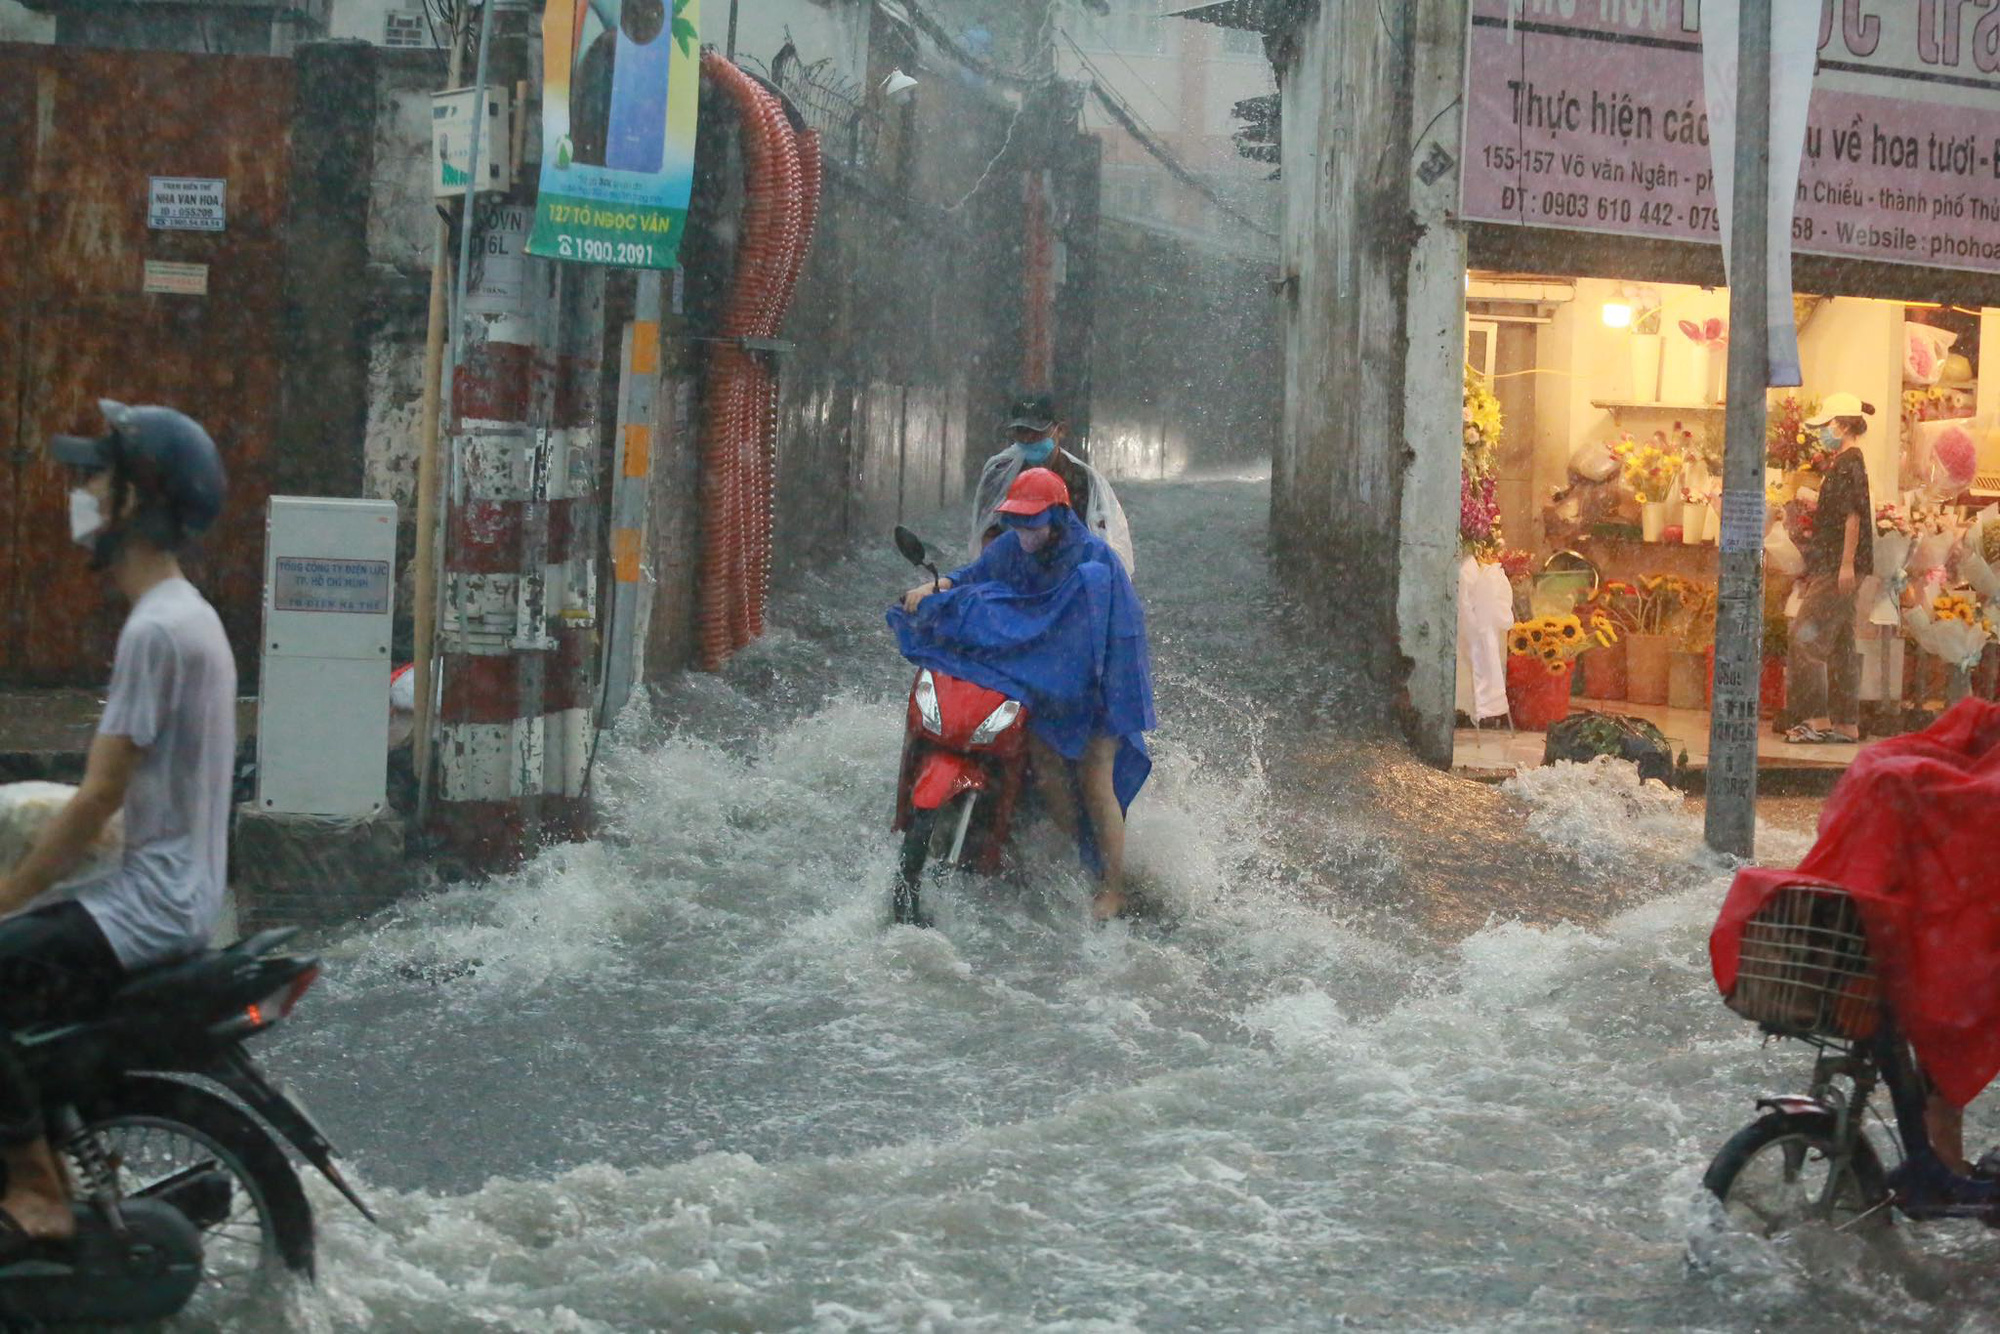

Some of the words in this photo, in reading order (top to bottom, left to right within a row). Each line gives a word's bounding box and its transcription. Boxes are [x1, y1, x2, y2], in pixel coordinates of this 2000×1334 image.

[1507, 80, 1581, 140] Thực
[1591, 90, 1652, 147] hiện
[1833, 113, 1862, 163] về
[1872, 124, 1918, 169] hoa
[1483, 145, 1555, 175] 155-157
[1561, 154, 1586, 178] Võ
[1592, 161, 1624, 183] văn
[1631, 161, 1678, 192] Ngân
[1542, 191, 1588, 218] 0903
[1598, 197, 1631, 223] 610
[1640, 202, 1673, 227] 442
[1814, 178, 1863, 207] Chiểu
[1879, 188, 1927, 214] thành
[1933, 193, 1967, 220] phố
[549, 204, 569, 223] 127
[594, 210, 637, 234] NGỌC
[640, 211, 670, 234] VÂN
[1792, 217, 1813, 241] 58
[576, 238, 653, 265] 1900.2091
